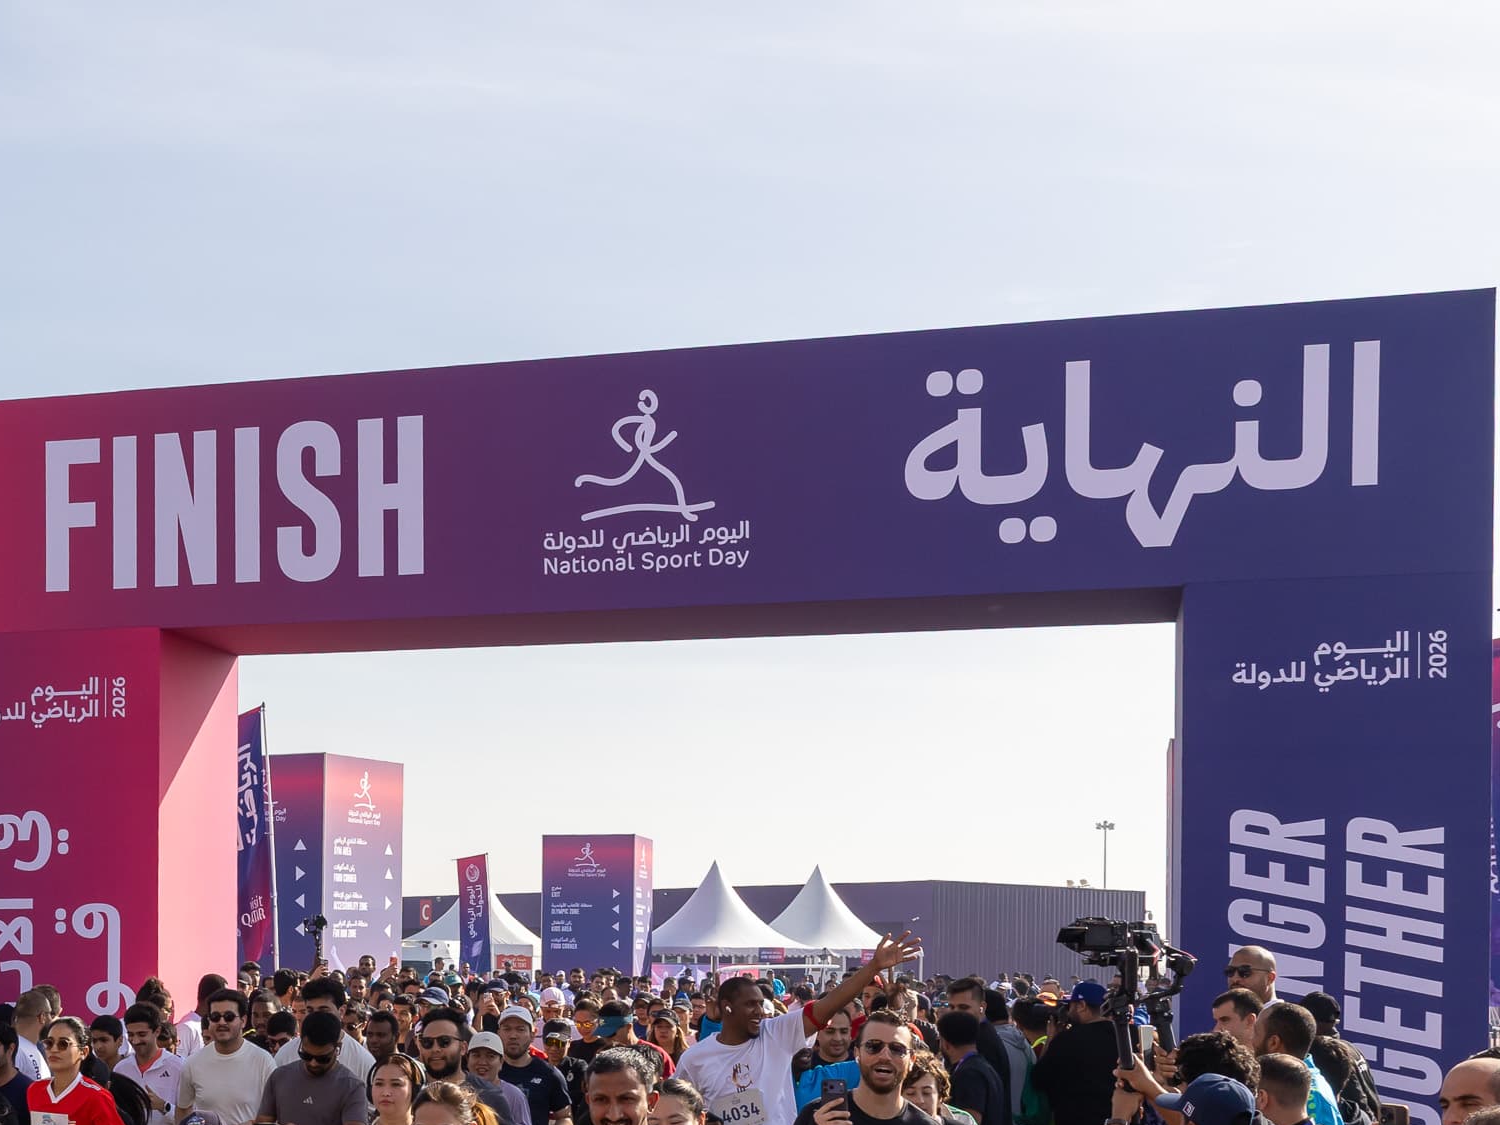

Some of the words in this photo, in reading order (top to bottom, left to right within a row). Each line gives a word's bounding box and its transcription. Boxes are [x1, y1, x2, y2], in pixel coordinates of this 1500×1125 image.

[904, 339, 1382, 548] النهاية
[45, 414, 425, 592] FINISH
[543, 529, 604, 554] للدولة
[612, 524, 690, 554] الرياضي
[699, 520, 750, 545] اليوم
[543, 553, 635, 575] National
[641, 550, 701, 572] Sport
[709, 548, 750, 568] Day
[1313, 630, 1409, 665] اليوم
[1428, 629, 1447, 679] 2026
[1231, 661, 1306, 690] للدولة
[1313, 657, 1409, 693] الرياضي
[30, 677, 99, 705] اليوم
[112, 676, 126, 718] 2026
[30, 700, 99, 728] الرياضي
[241, 907, 266, 928] QATAR
[421, 904, 430, 920] C
[1228, 808, 1326, 1001] NGER
[55, 903, 137, 1016] قو
[722, 1102, 760, 1123] 4034
